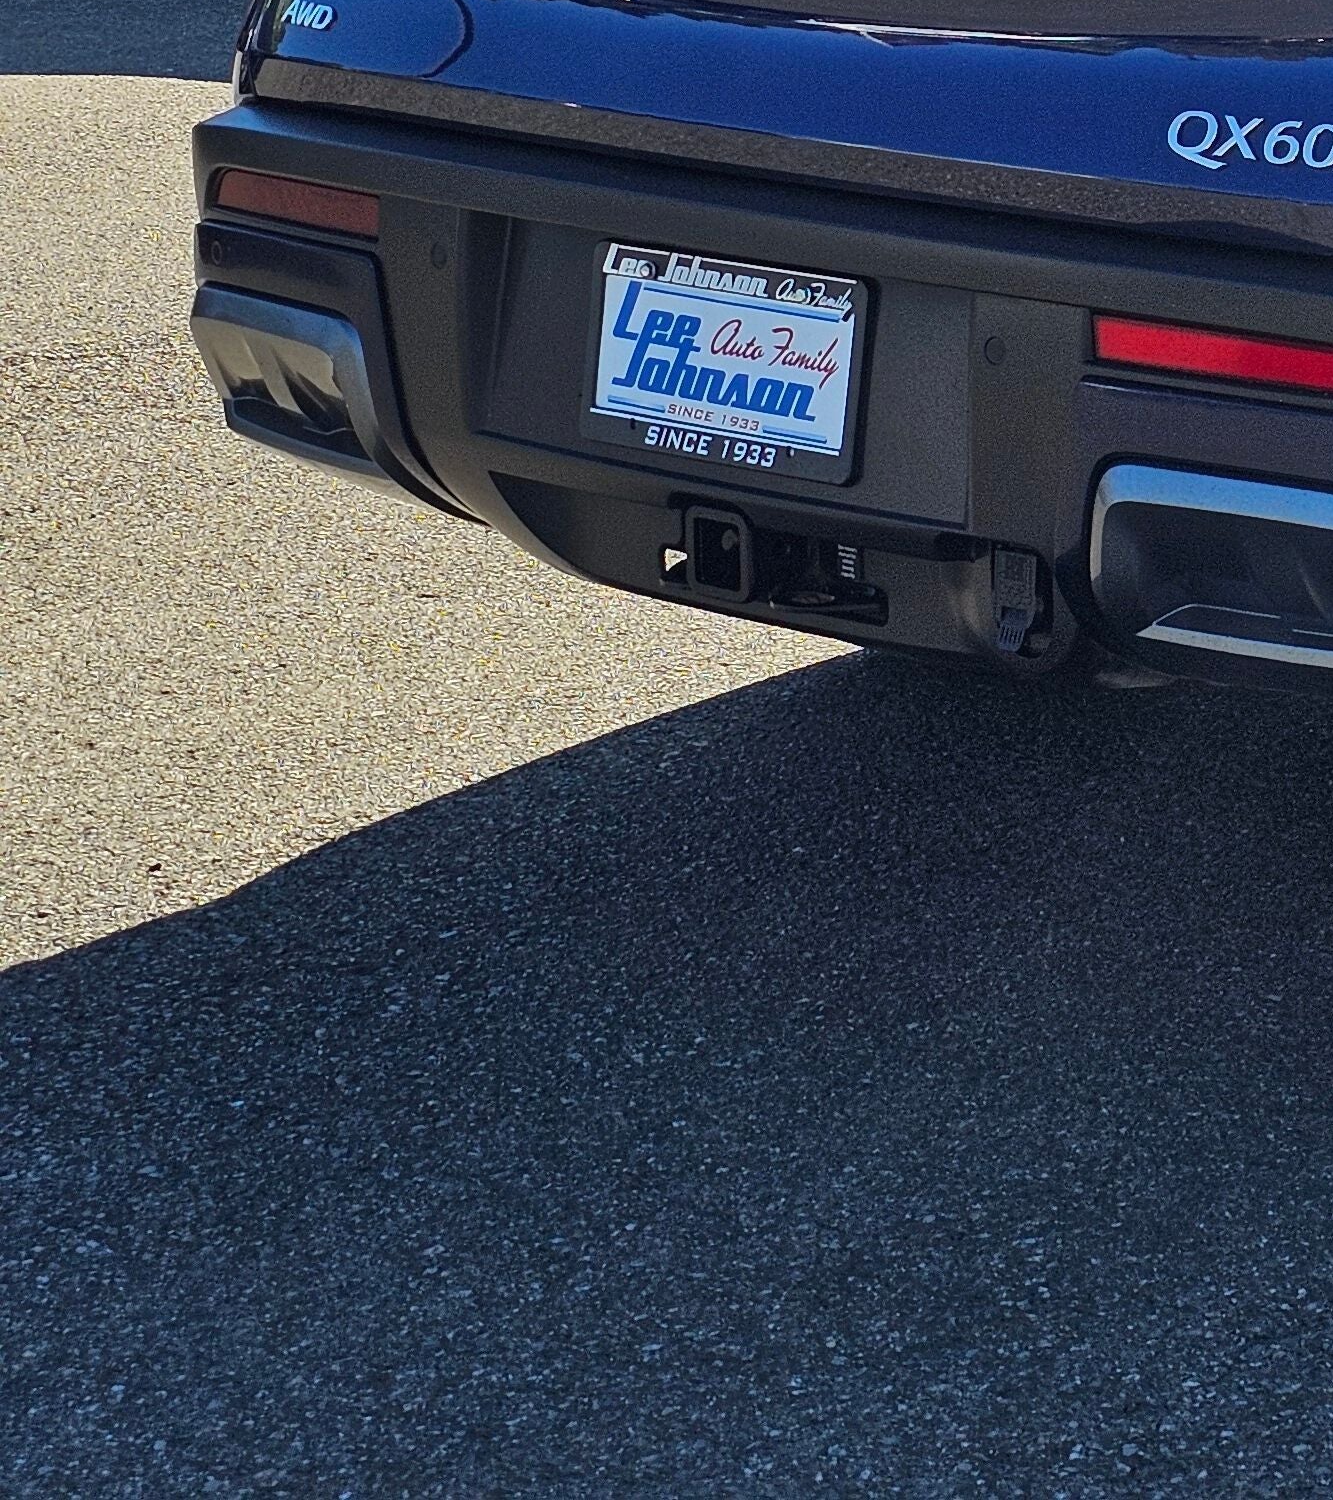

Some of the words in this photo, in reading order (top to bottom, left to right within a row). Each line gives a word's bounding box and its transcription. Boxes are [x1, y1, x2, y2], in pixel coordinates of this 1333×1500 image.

[281, 0, 333, 30] AWD
[603, 243, 655, 279] Le
[657, 252, 769, 298] Johnson
[612, 280, 701, 352] Lee
[711, 319, 764, 360] Auto
[768, 327, 839, 389] Family
[612, 338, 816, 422] Johnson
[667, 404, 714, 422] SINCE
[721, 414, 760, 432] 1933
[644, 426, 713, 456] SINCE
[721, 440, 776, 467] 1933
